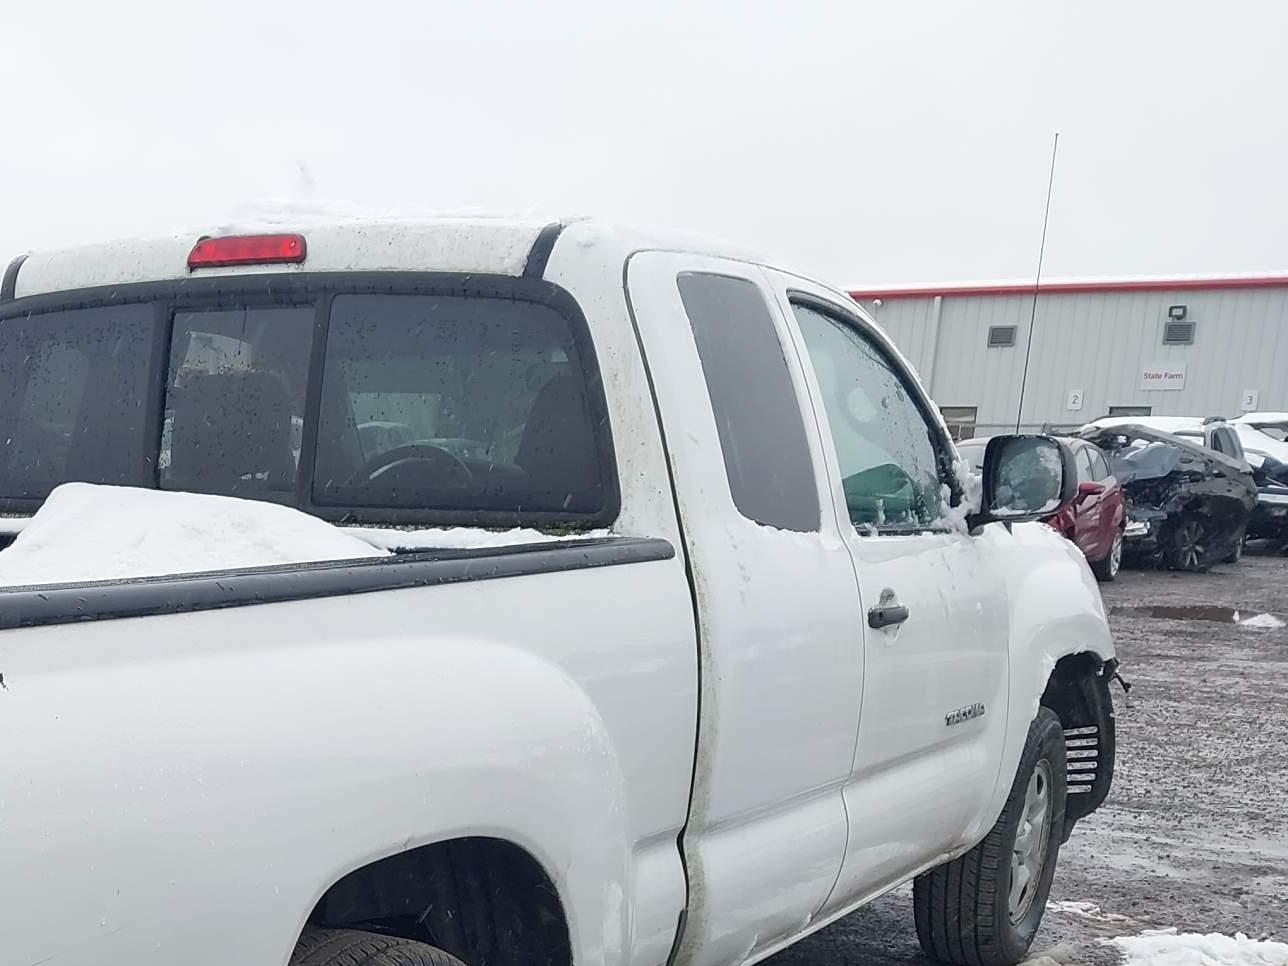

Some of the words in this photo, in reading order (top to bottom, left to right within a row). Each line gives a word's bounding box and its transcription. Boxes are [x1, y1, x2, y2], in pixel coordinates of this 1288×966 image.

[1143, 371, 1163, 380] State
[1164, 372, 1184, 380] Farm
[1071, 394, 1079, 404] 2
[1246, 395, 1254, 405] 3
